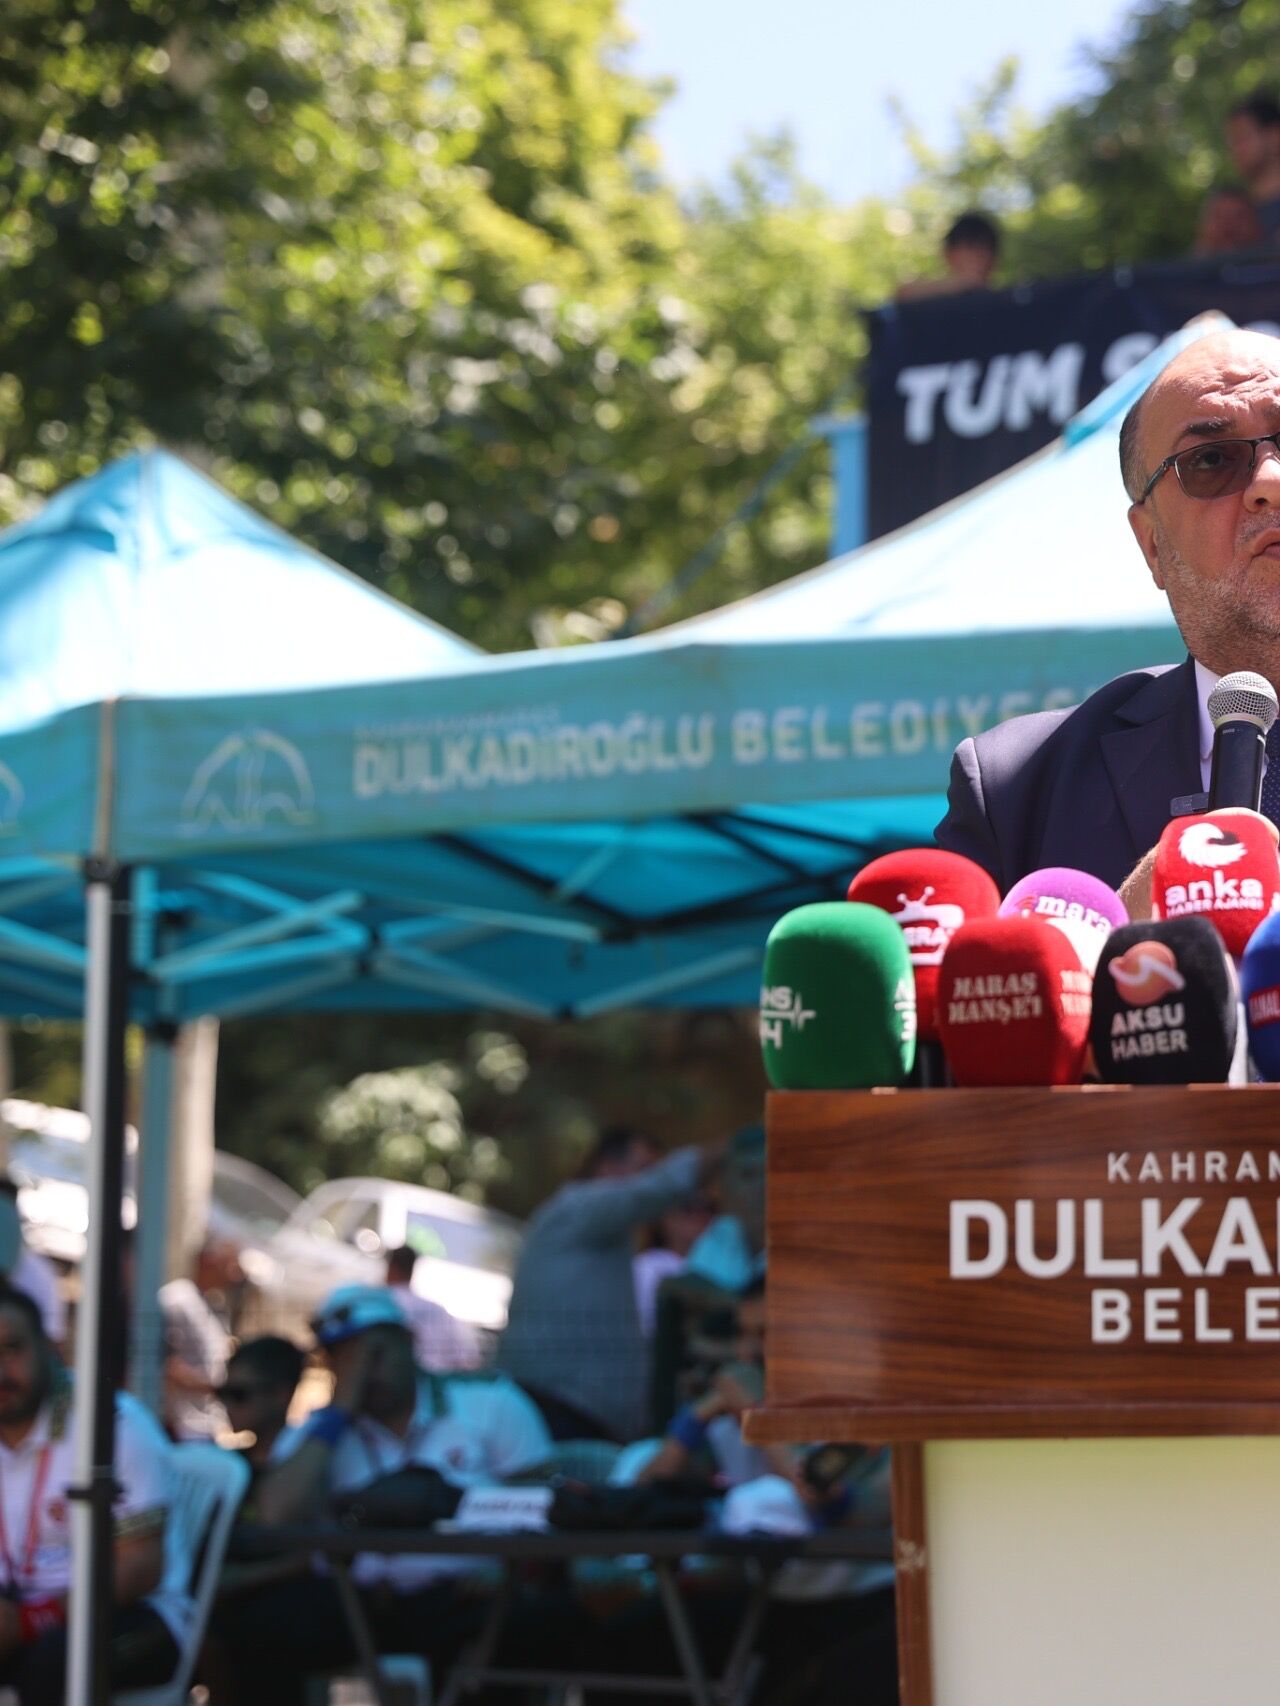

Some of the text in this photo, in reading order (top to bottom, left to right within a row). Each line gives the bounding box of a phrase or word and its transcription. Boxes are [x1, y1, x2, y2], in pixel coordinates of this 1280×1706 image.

[1165, 869, 1263, 907] anka
[1110, 1002, 1186, 1037] AKSU
[1112, 1029, 1188, 1062] HABER
